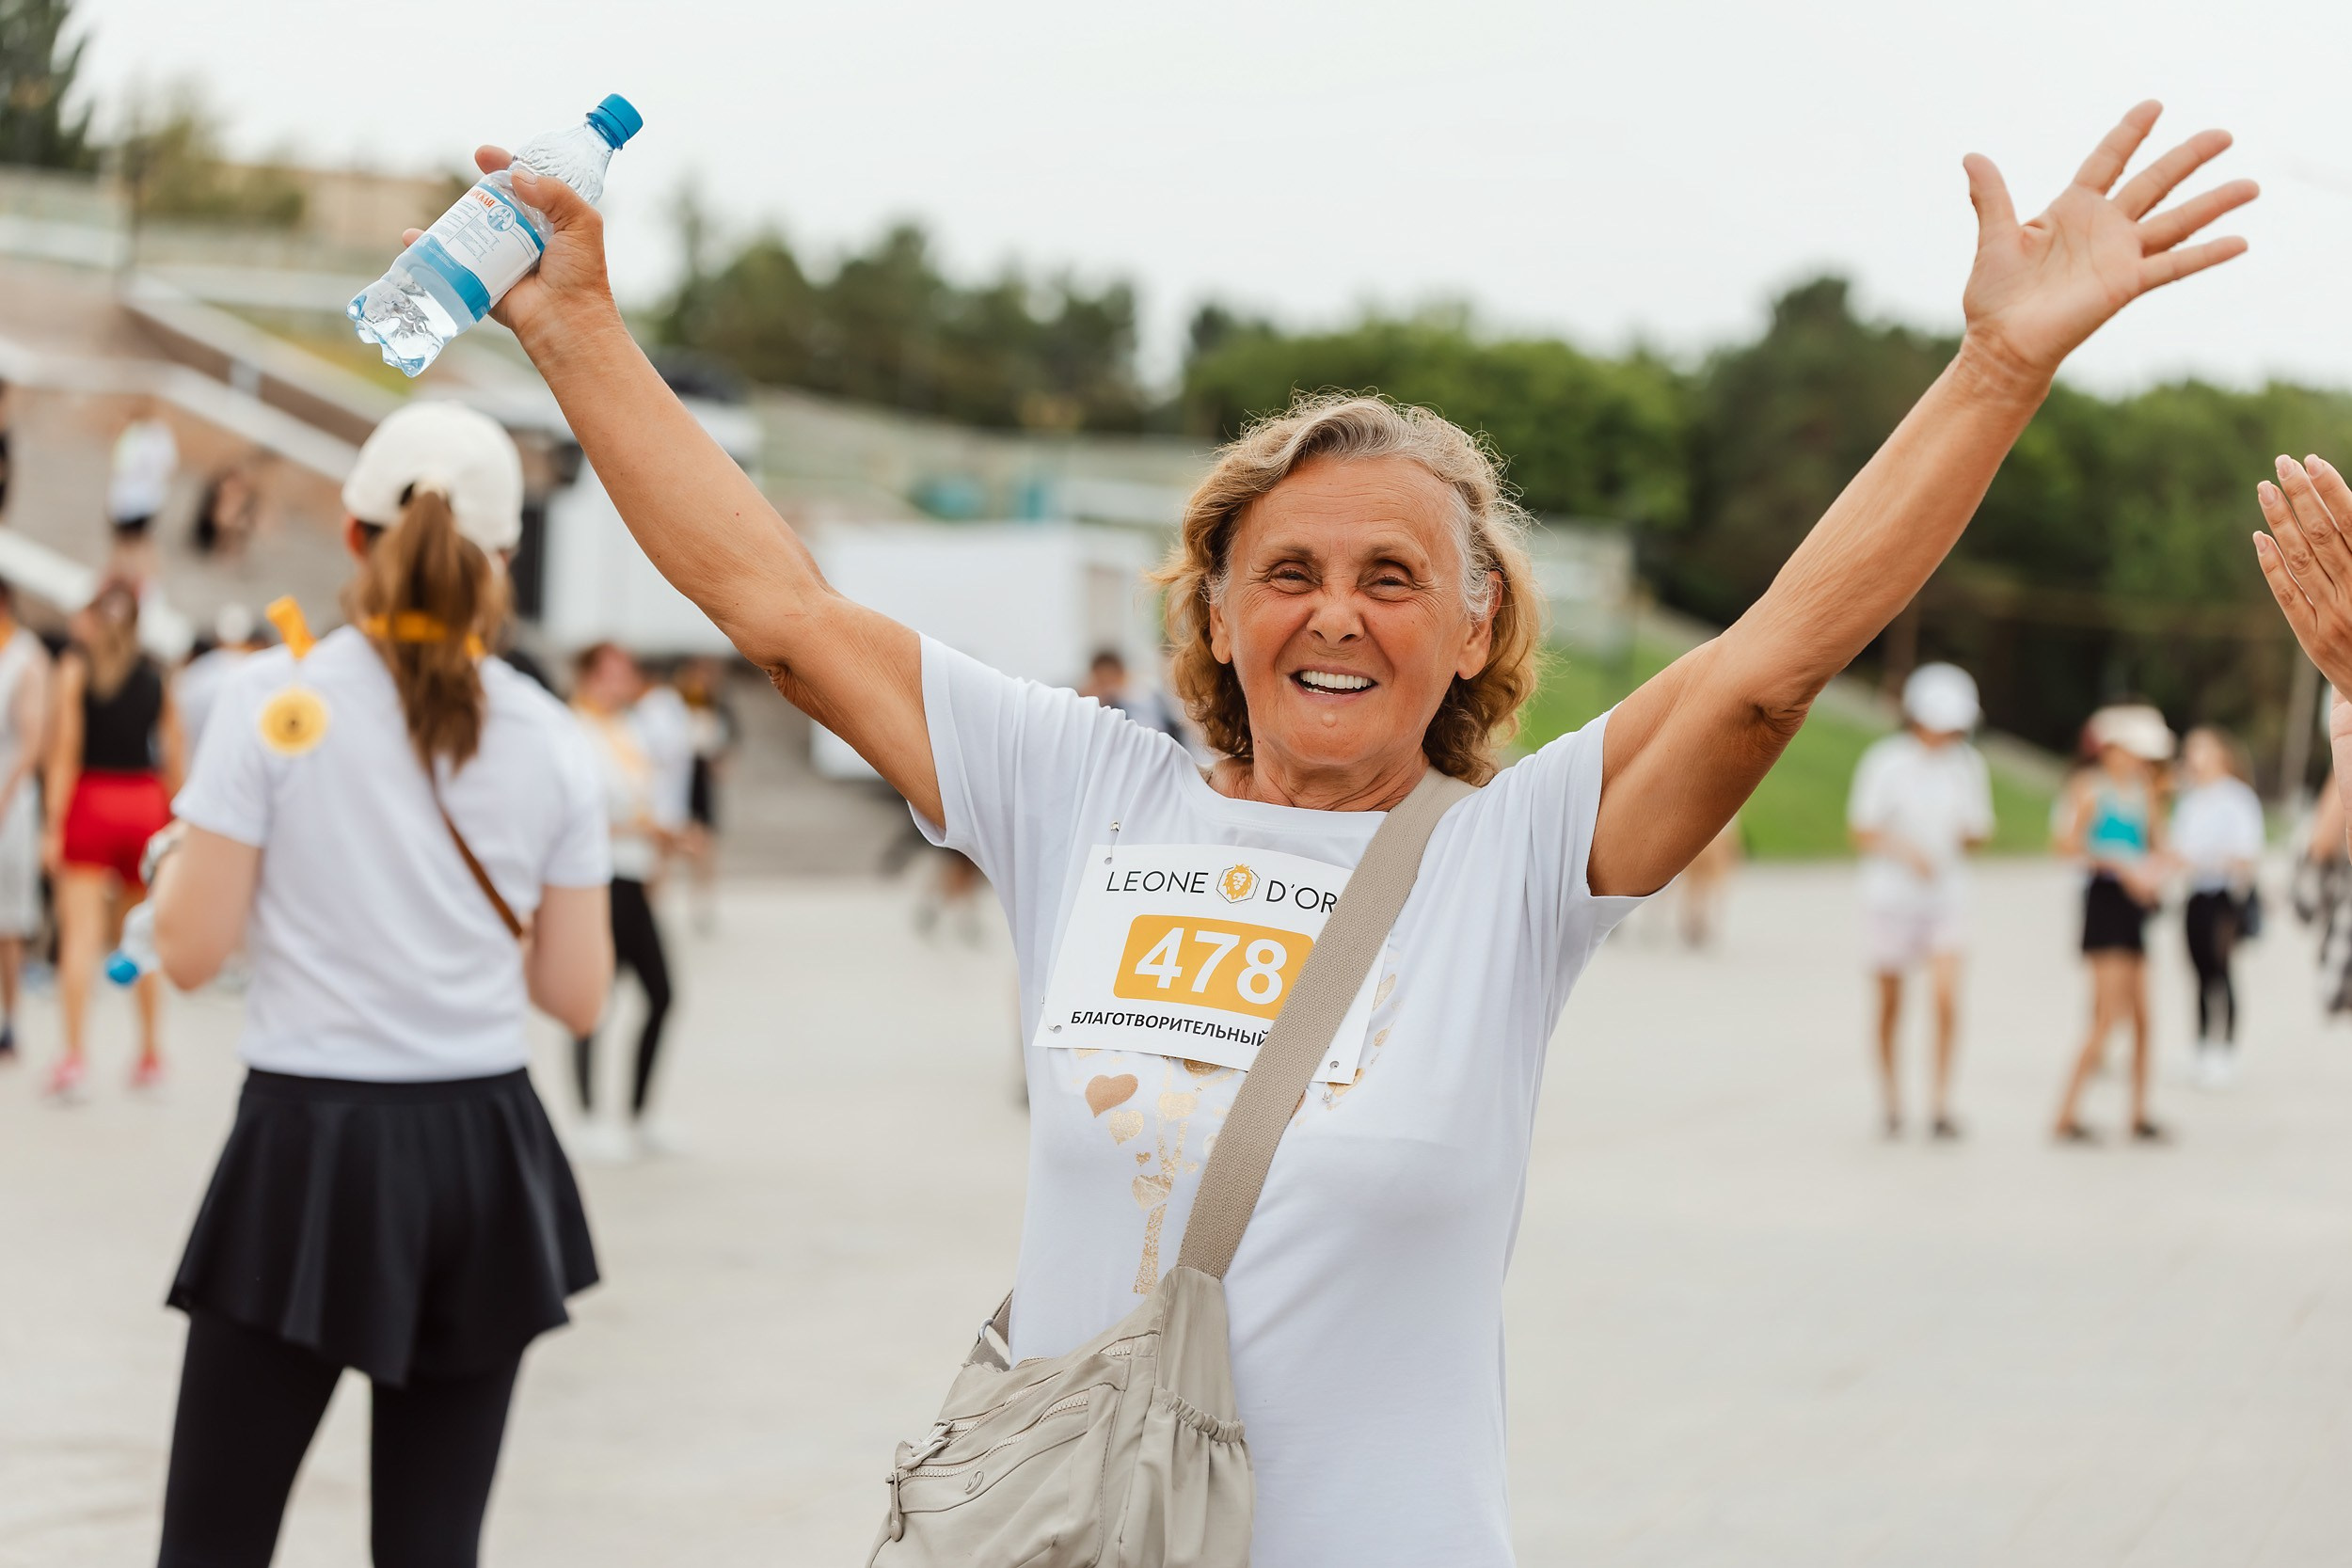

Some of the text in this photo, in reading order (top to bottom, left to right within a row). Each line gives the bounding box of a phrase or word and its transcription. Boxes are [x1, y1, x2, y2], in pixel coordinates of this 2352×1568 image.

[1105, 870, 1209, 894] LEONE
[1135, 927, 1288, 1005] 478
[1071, 1011, 1269, 1047] БЛАГОТВОРИТЕЛЬНЫЙ
